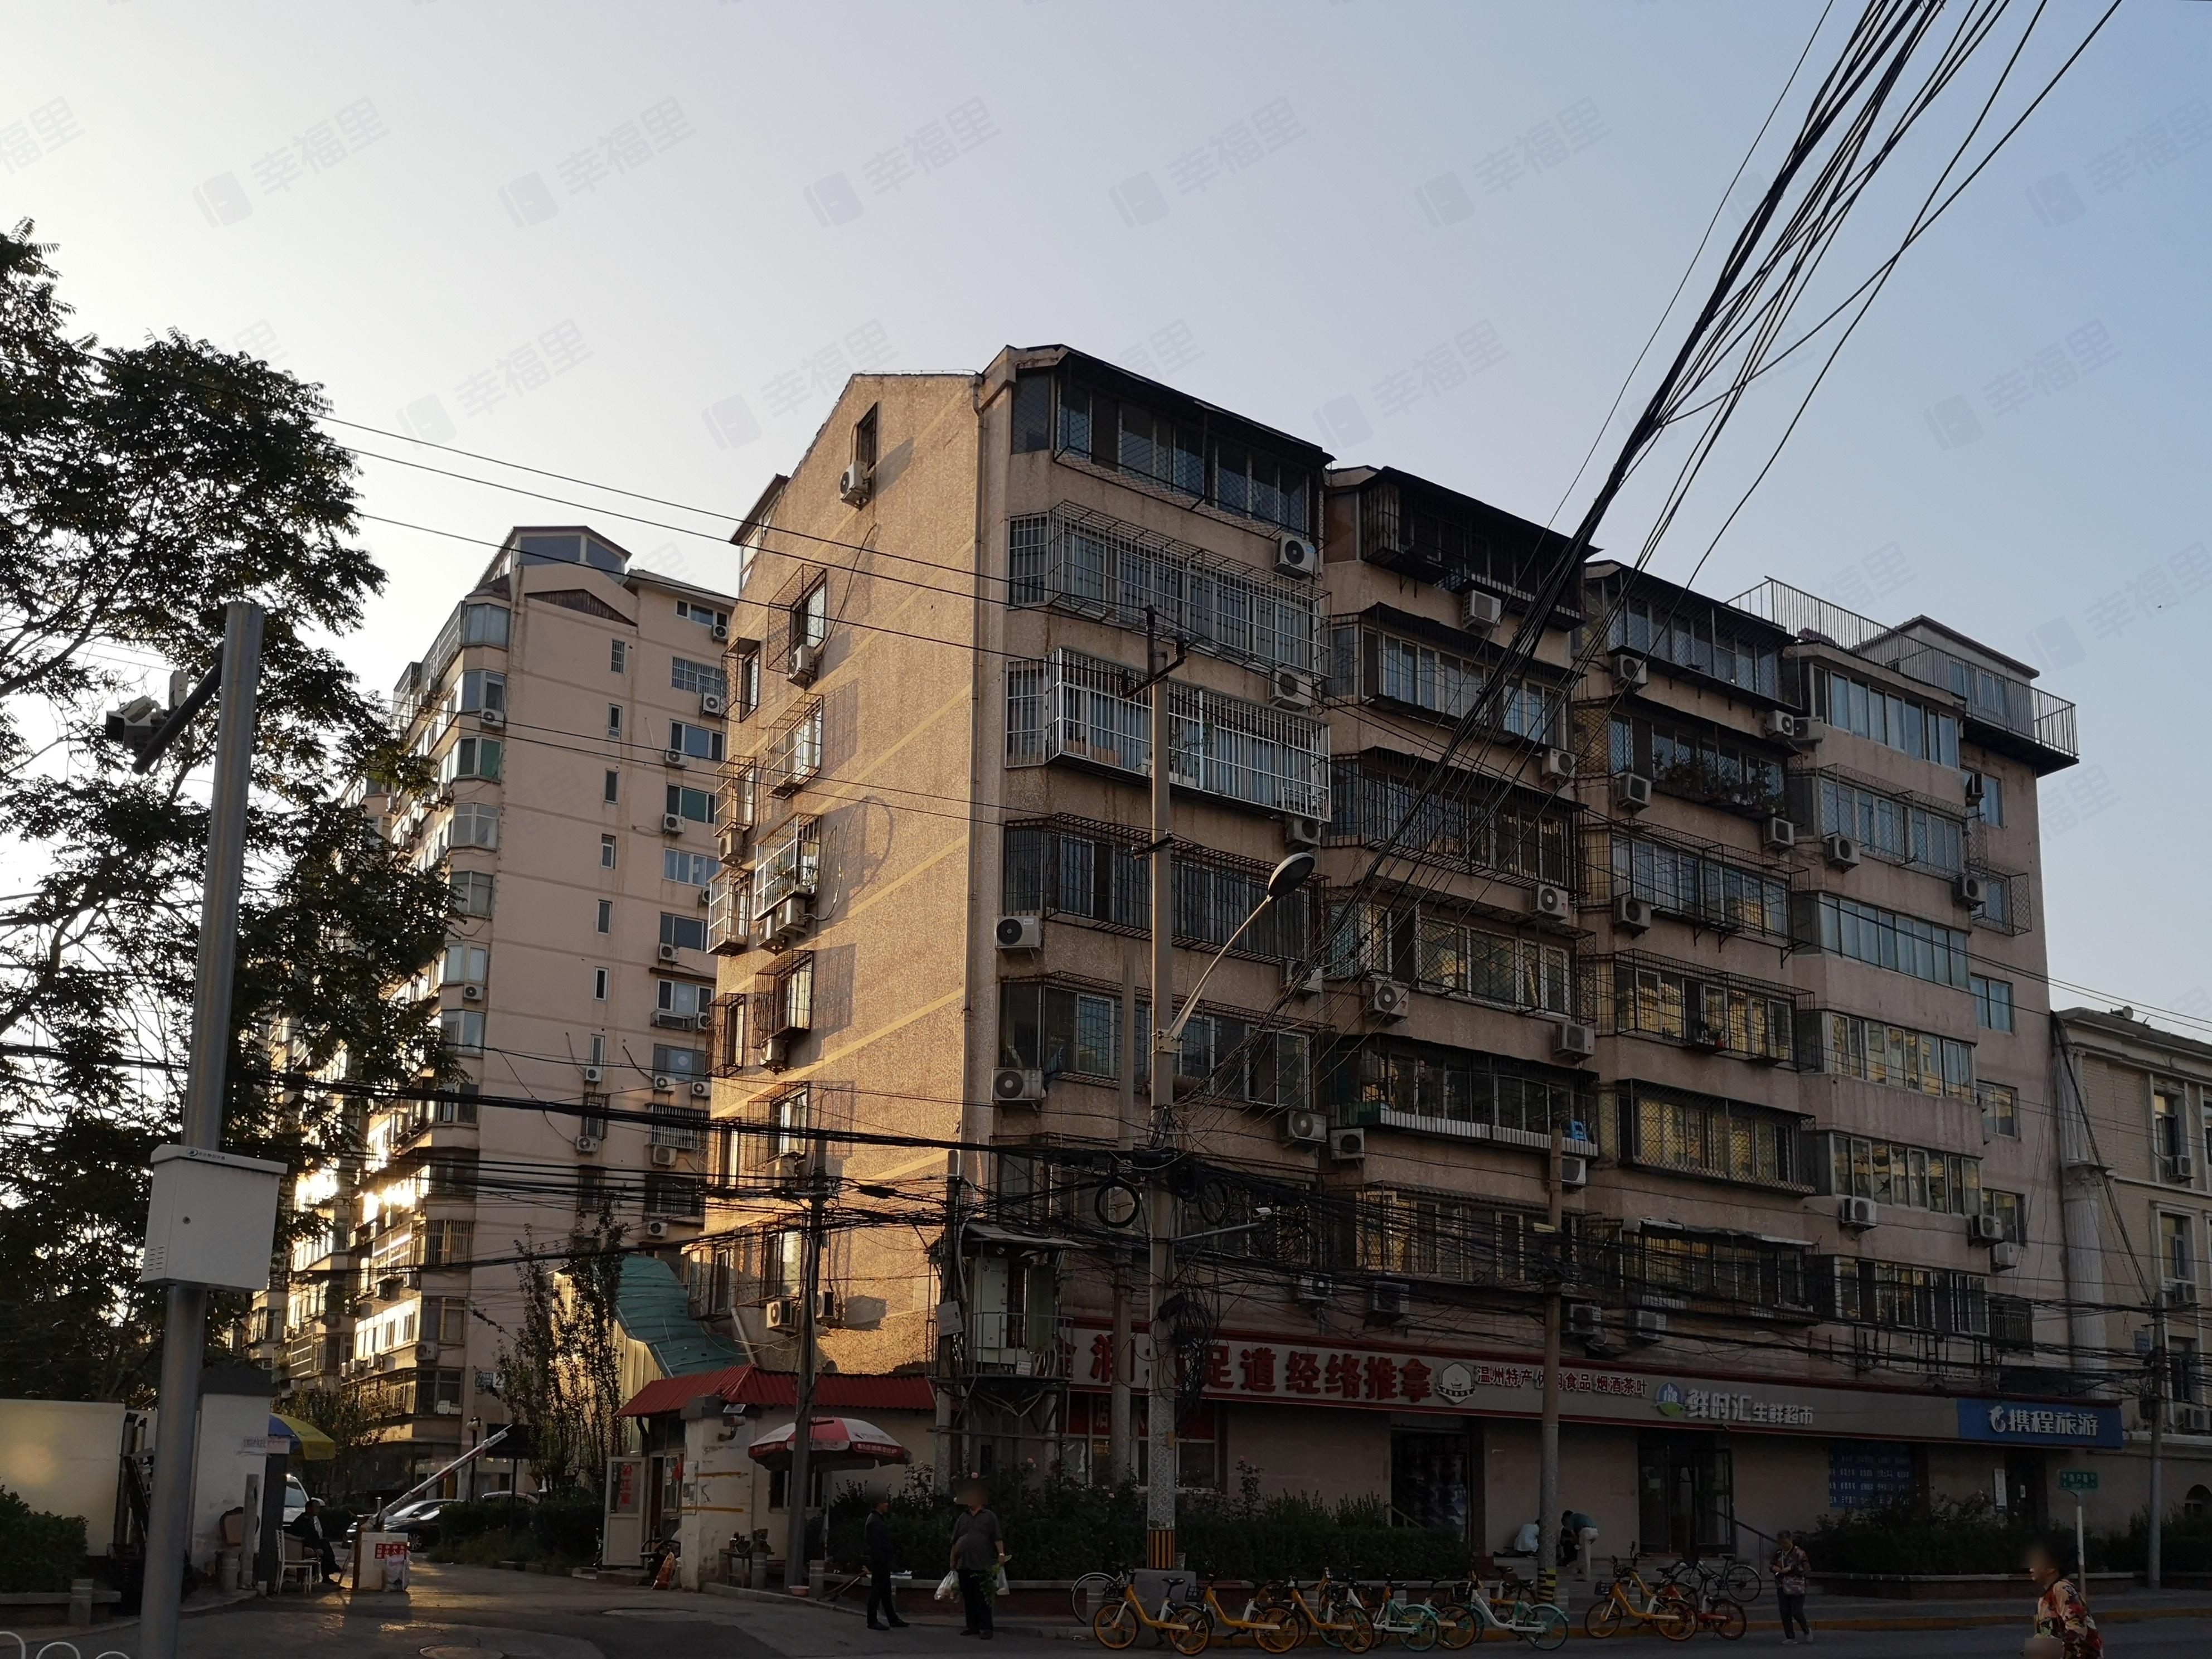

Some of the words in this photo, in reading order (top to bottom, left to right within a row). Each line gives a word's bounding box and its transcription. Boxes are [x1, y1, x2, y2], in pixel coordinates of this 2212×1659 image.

[1477, 1366, 1532, 1388] 温州特产
[1597, 1375, 1647, 1396] 烟酒茶叶
[2009, 1409, 2099, 1436] 携程旅游
